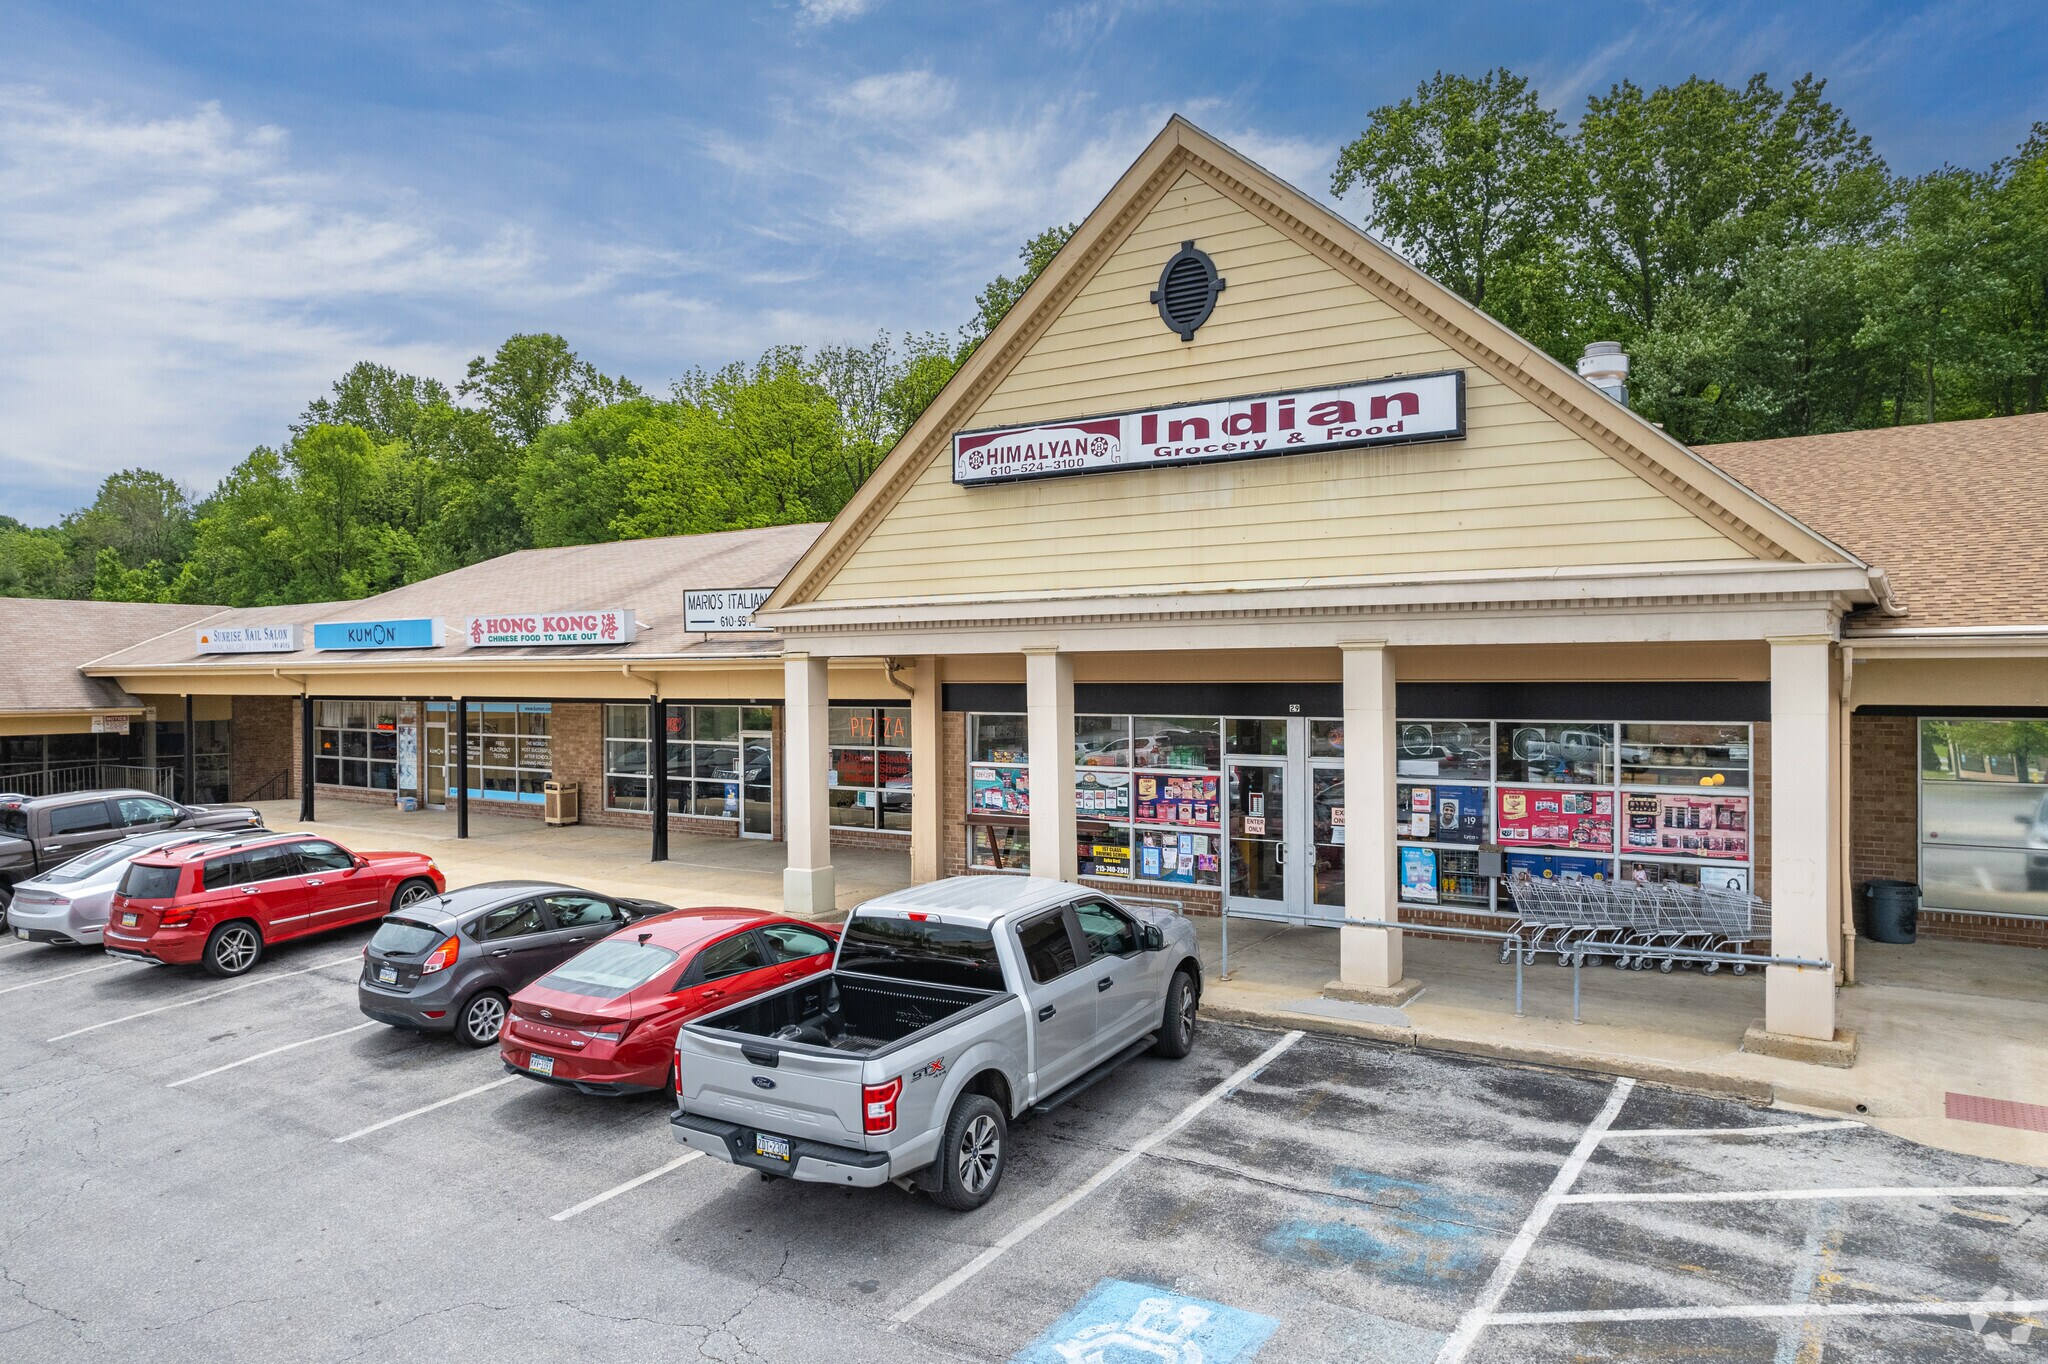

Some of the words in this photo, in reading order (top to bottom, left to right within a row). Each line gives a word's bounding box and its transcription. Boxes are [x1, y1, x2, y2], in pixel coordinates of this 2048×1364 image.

[1141, 392, 1420, 445] Indian
[1153, 438, 1268, 458] Grocery
[1286, 432, 1306, 444] &
[1326, 420, 1404, 441] Food
[986, 437, 1089, 466] HIMALYAN
[990, 457, 1085, 476] 610-524-3100
[688, 593, 723, 611] MARIO'S
[471, 618, 484, 644] 香
[486, 618, 537, 634] HONG
[542, 615, 598, 633] KONG
[213, 630, 242, 642] SUNRISE
[244, 628, 262, 641] NAIL
[264, 627, 288, 640] SALON
[348, 624, 395, 645] KUMON
[488, 635, 519, 643] CHINESE
[520, 634, 541, 642] FOOD
[557, 633, 578, 641] TAKE
[581, 632, 598, 640] OUT
[1290, 704, 1300, 712] 29
[851, 718, 904, 737] PIZZA
[879, 764, 908, 774] Slices
[525, 1025, 568, 1037] ELANTRA
[911, 1056, 946, 1083] STX
[756, 1079, 771, 1088] Ford
[718, 1096, 821, 1127] F-150
